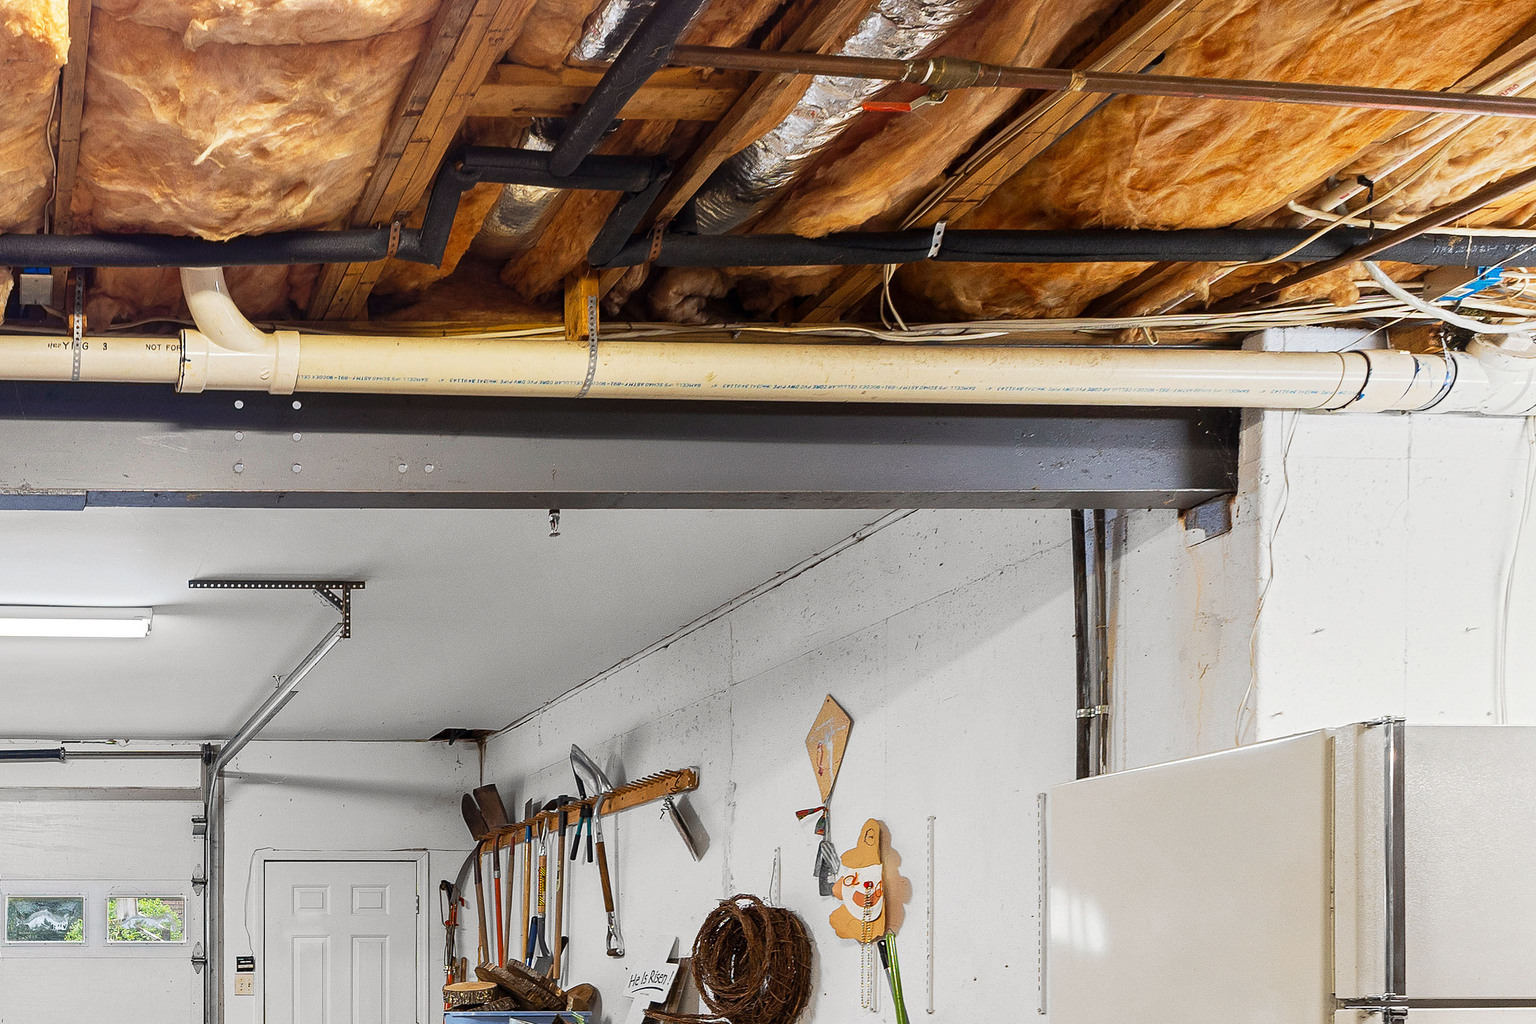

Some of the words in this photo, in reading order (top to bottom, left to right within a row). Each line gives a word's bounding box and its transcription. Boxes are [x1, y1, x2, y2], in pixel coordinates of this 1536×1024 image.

[62, 341, 89, 350] YIG
[145, 343, 162, 351] NOT
[628, 973, 641, 988] He
